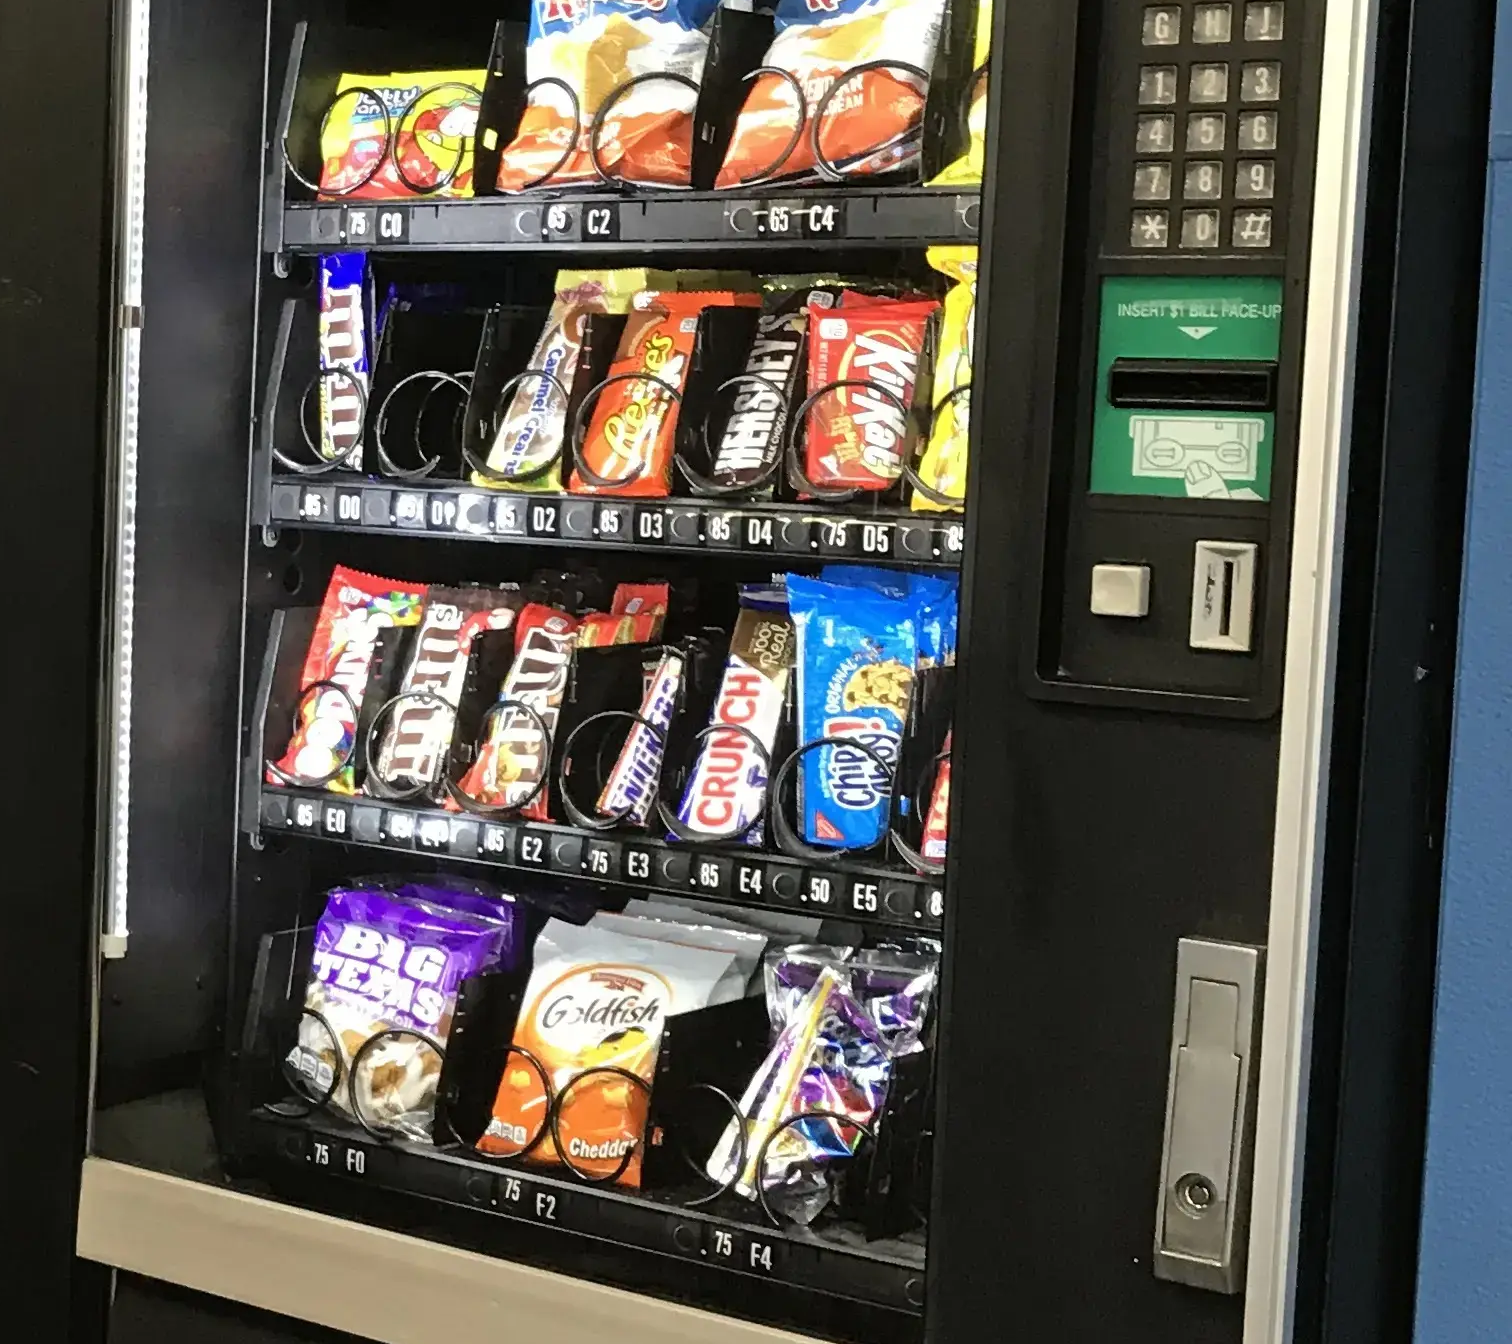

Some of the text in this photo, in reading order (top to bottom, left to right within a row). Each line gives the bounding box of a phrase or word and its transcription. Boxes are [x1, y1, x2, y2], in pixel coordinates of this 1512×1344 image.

[1154, 12, 1169, 40] G
[1205, 9, 1221, 37] H
[1260, 6, 1271, 34] J
[1154, 71, 1164, 99] 1
[1203, 68, 1216, 97] 2
[1255, 66, 1269, 95] 3
[1149, 119, 1164, 146] 4
[1200, 116, 1214, 145] 5
[1253, 115, 1267, 143] 6
[1149, 165, 1162, 193] 7
[1199, 164, 1213, 193] 8
[1251, 163, 1265, 192] 9
[340, 212, 366, 238] .75
[588, 209, 611, 235] C2
[758, 206, 835, 233] .65 C4
[1197, 213, 1210, 241] 0
[1240, 212, 1271, 240] #
[1117, 301, 1167, 319] INSERT
[1189, 302, 1218, 319] BILL
[1221, 302, 1283, 320] FACE-UP
[531, 347, 564, 414] Caramel
[714, 312, 806, 477] HERSHEY'S
[593, 510, 663, 539] .85 D3
[699, 519, 773, 545] .85 D4
[810, 523, 889, 553] .75 D5
[760, 621, 791, 669] Real
[696, 668, 763, 829] CRUNCH
[522, 836, 543, 863] E2
[580, 850, 650, 878] .75 E3
[690, 863, 763, 895] .85 E4
[801, 878, 878, 913] .50 E5
[335, 923, 450, 984] BIG
[313, 951, 447, 1026] TEXAS
[542, 994, 661, 1030] Goldfish
[306, 1142, 329, 1165] .75
[490, 1178, 557, 1220] .75 F2
[699, 1230, 773, 1271] .75 F4
